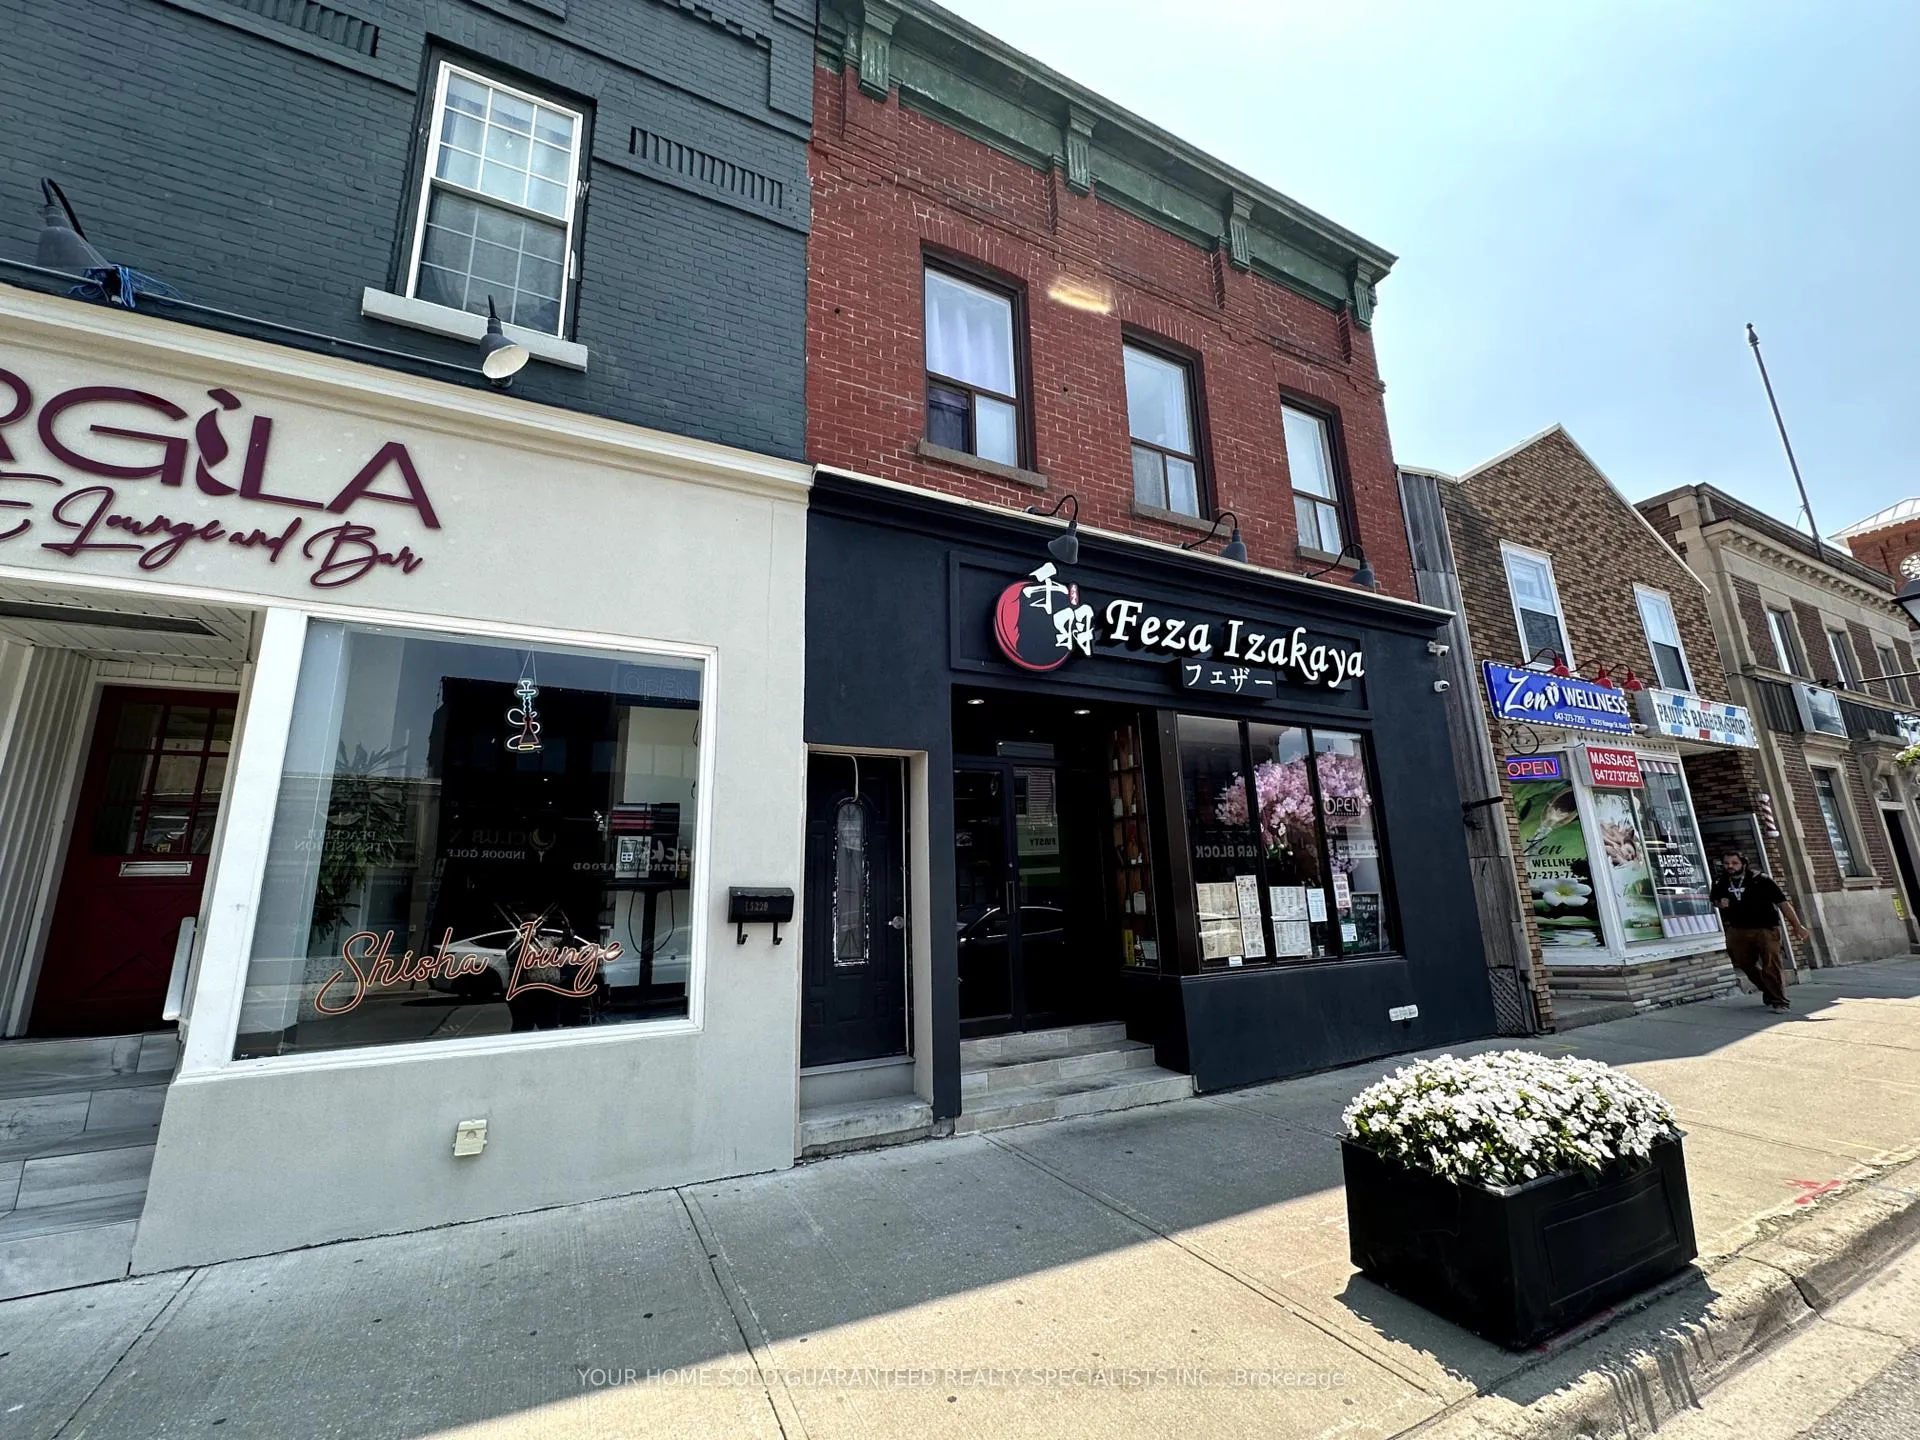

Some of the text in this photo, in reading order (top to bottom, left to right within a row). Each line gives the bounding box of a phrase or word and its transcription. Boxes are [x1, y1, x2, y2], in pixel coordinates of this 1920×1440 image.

[228, 517, 302, 562] and
[302, 521, 424, 588] Bar
[1106, 599, 1365, 688] Feza Izakaya
[1183, 664, 1274, 693] フェザー
[1504, 671, 1627, 716] Zen WELLNESS
[1657, 703, 1747, 736] PAUL'S BARBER SHOP
[1507, 760, 1557, 776] OPEN
[1590, 752, 1636, 768] MASSAGE
[1594, 769, 1639, 783] 6472737255
[1324, 797, 1361, 815] OPEN
[314, 921, 624, 1014] Shisha Lounge
